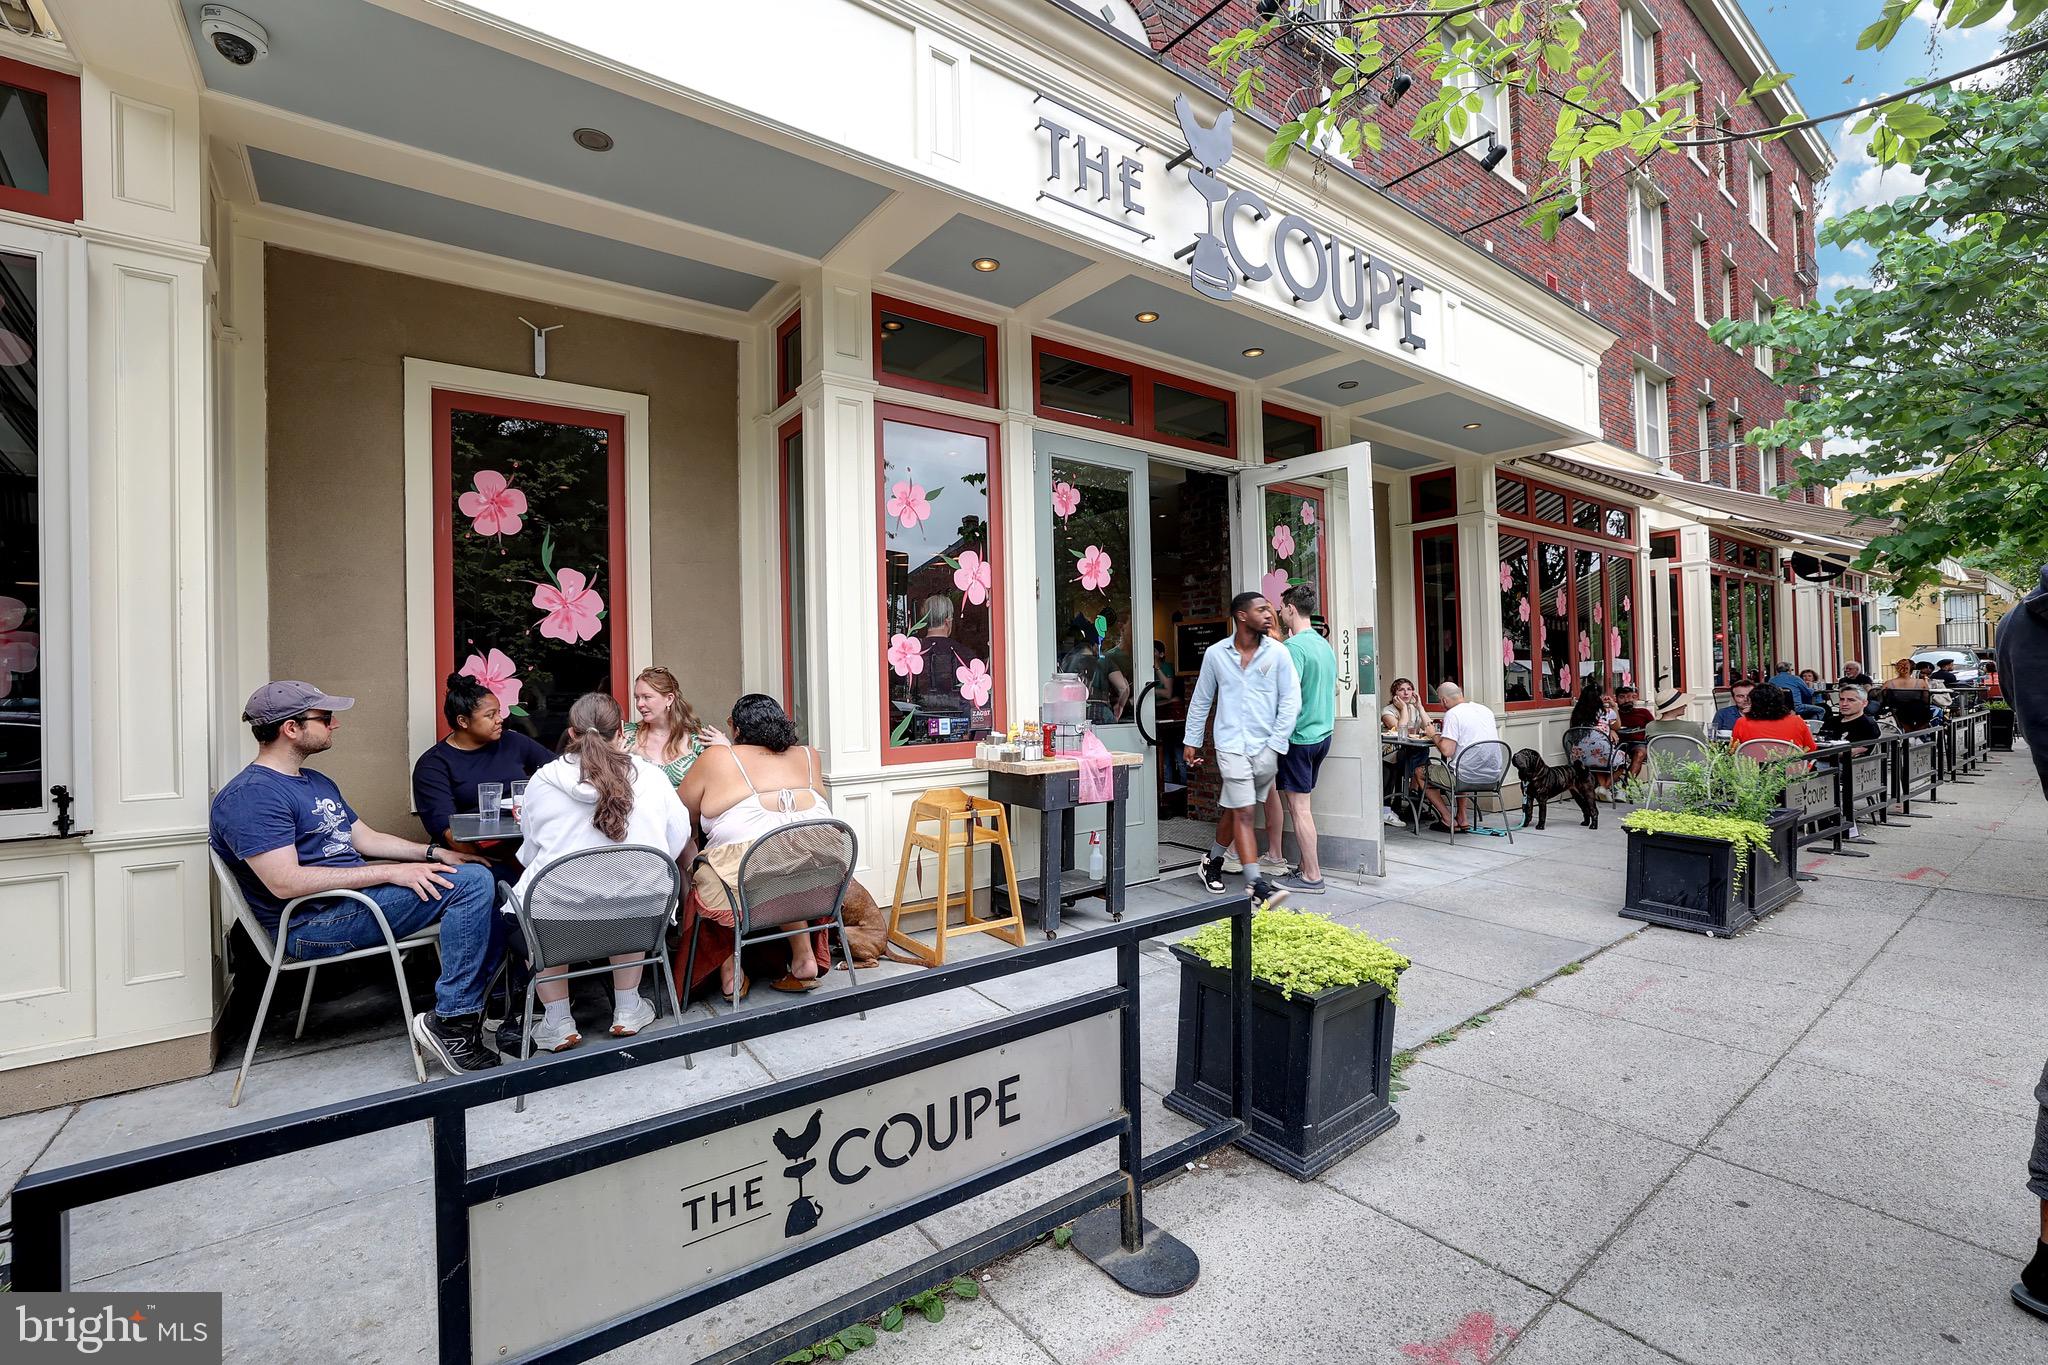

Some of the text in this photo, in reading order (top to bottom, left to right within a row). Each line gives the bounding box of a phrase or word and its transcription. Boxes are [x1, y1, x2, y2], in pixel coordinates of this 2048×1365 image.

[1038, 116, 1426, 350] THE COUPE
[1342, 629, 1351, 691] 3415
[1807, 785, 1828, 806] COUPE
[682, 1074, 1021, 1231] THE COUPE
